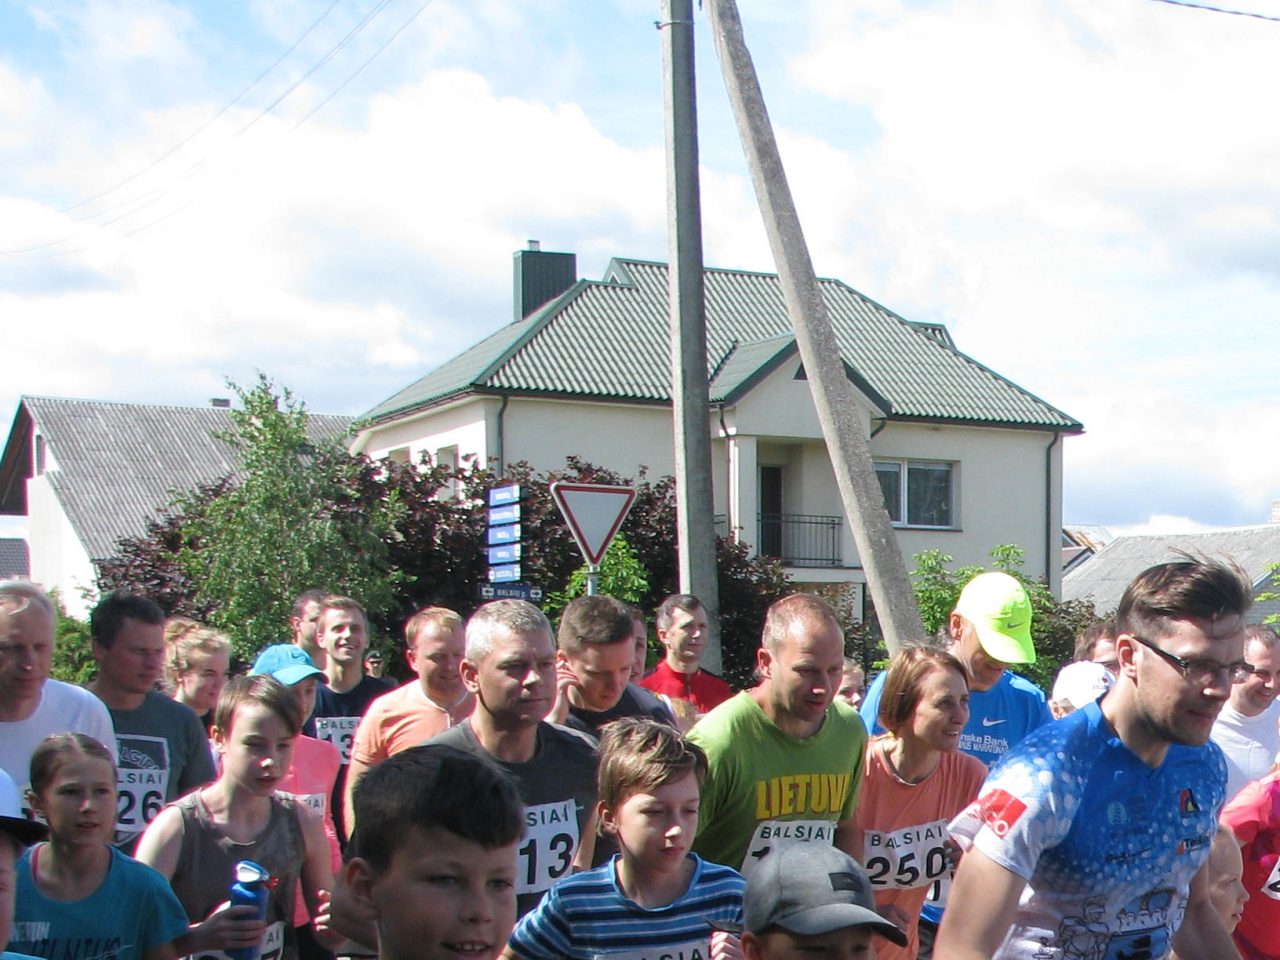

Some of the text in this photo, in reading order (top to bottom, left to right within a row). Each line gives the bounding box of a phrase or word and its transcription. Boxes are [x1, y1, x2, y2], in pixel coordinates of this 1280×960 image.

[960, 733, 983, 744] nske
[983, 734, 1009, 748] Bank
[117, 790, 164, 825] 26
[526, 805, 569, 827] SIAI
[760, 826, 831, 840] BALSIAI
[870, 828, 943, 849] BALSIAI
[519, 833, 574, 885] 13
[866, 846, 947, 886] 250
